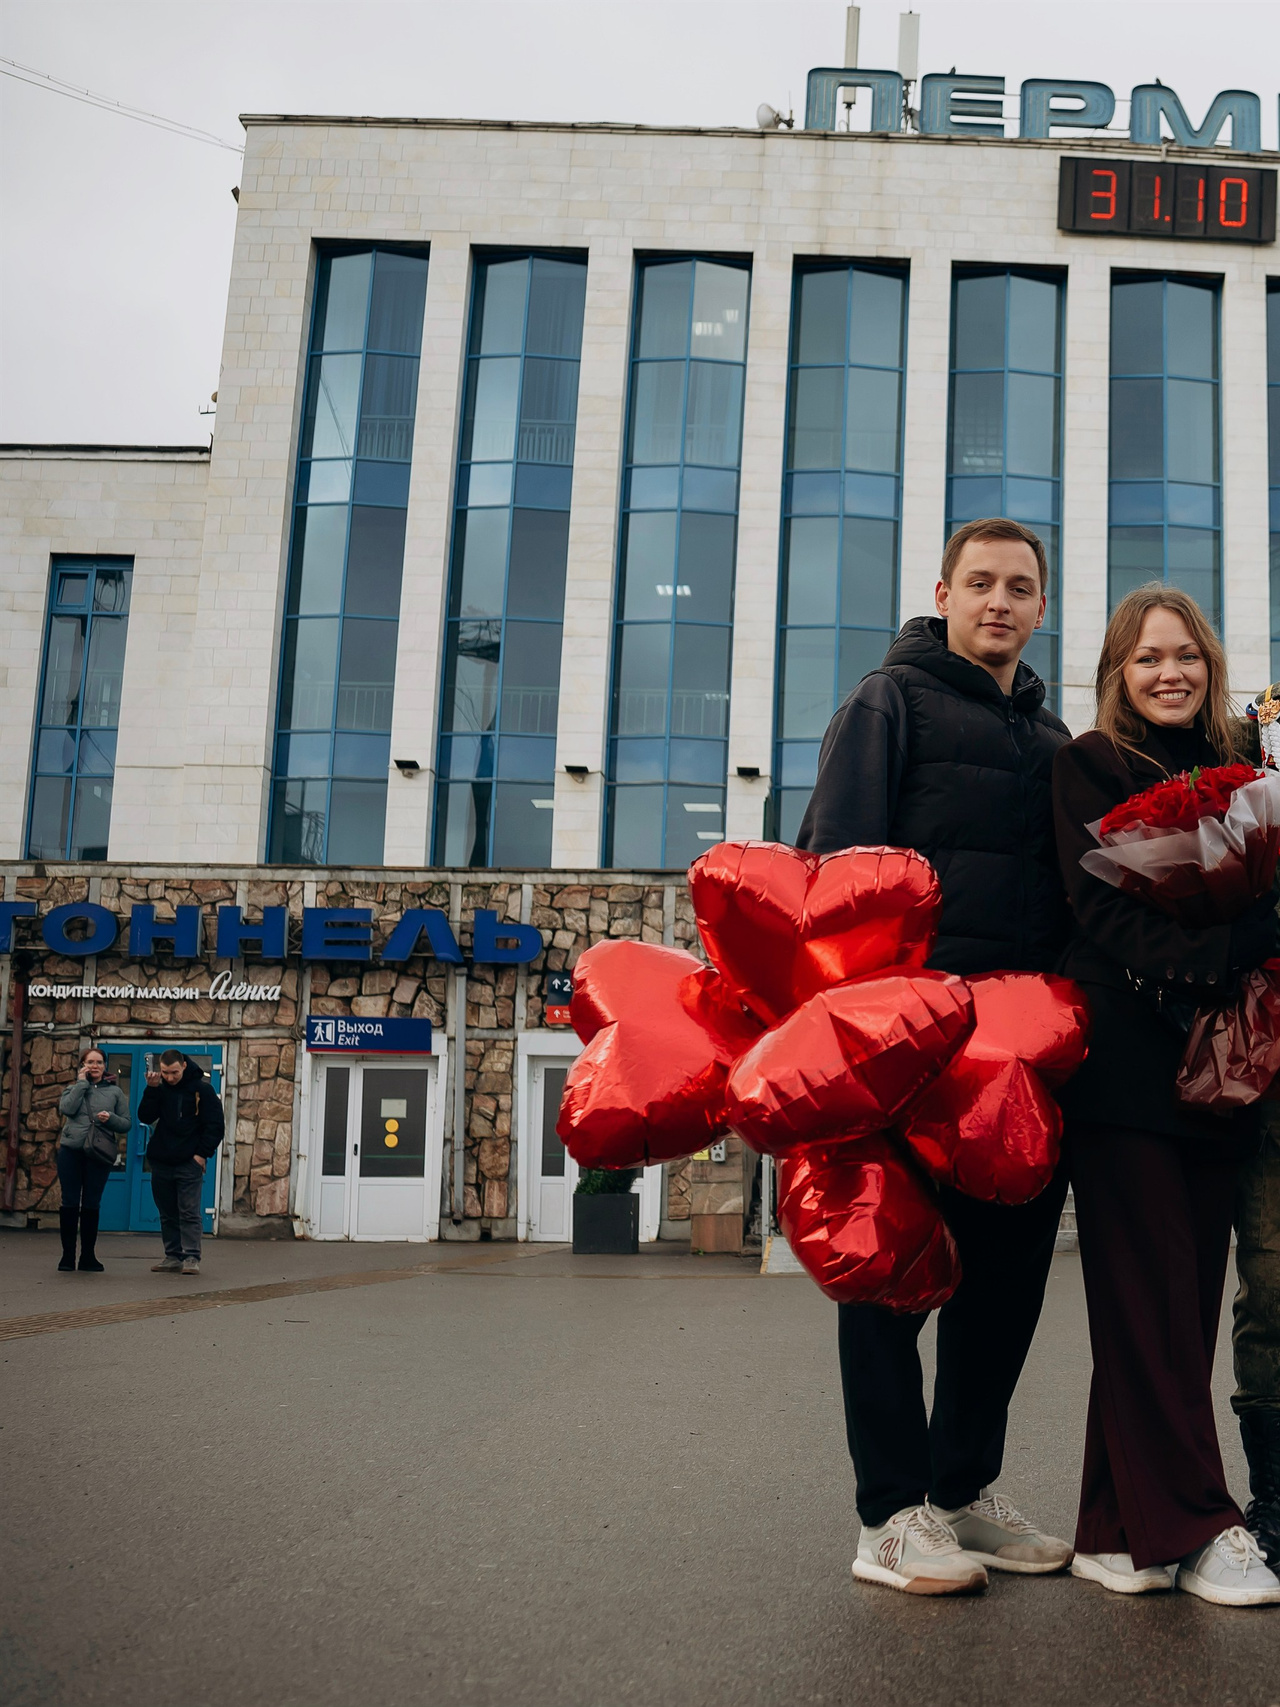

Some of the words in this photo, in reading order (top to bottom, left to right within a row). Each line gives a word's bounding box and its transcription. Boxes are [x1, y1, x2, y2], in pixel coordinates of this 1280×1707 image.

[1090, 170, 1248, 227] 31.10
[28, 984, 136, 999] КОНДИТЕРСКИЙ
[137, 985, 199, 1000] МАГАЗИН
[209, 970, 282, 1001] Алёнка
[337, 1020, 384, 1036] Выход
[337, 1034, 360, 1046] Exit
